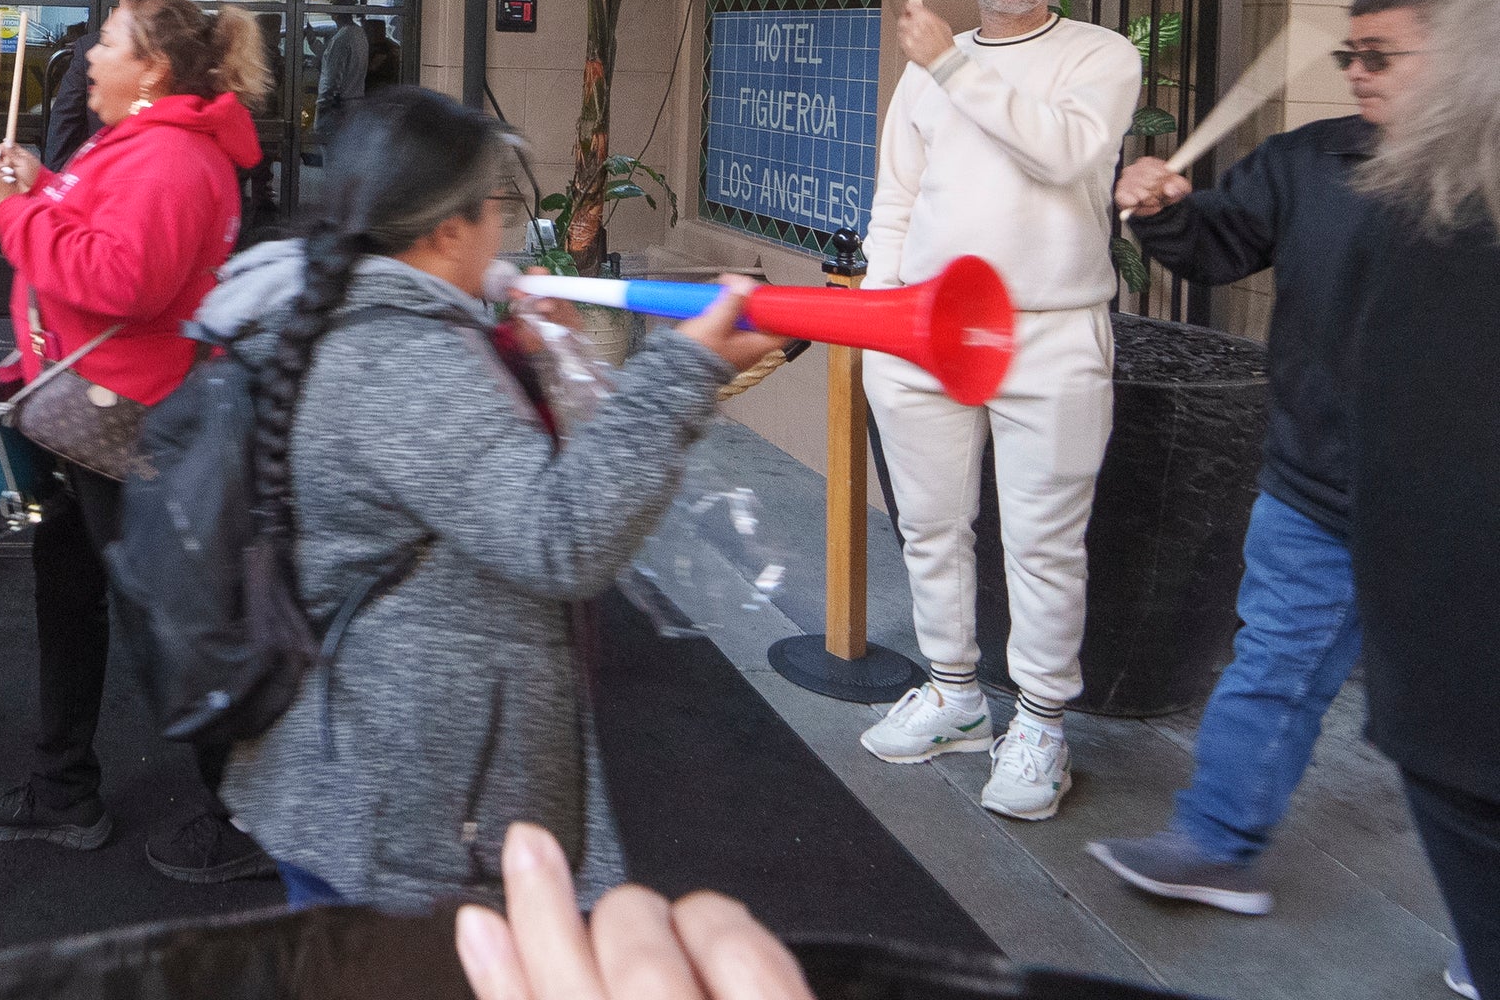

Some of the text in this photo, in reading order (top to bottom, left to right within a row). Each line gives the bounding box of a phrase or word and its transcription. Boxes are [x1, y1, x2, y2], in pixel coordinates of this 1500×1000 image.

[755, 23, 823, 65] HOTEL
[739, 87, 838, 138] FIGUEROA
[719, 158, 859, 228] LOS ANGELES
